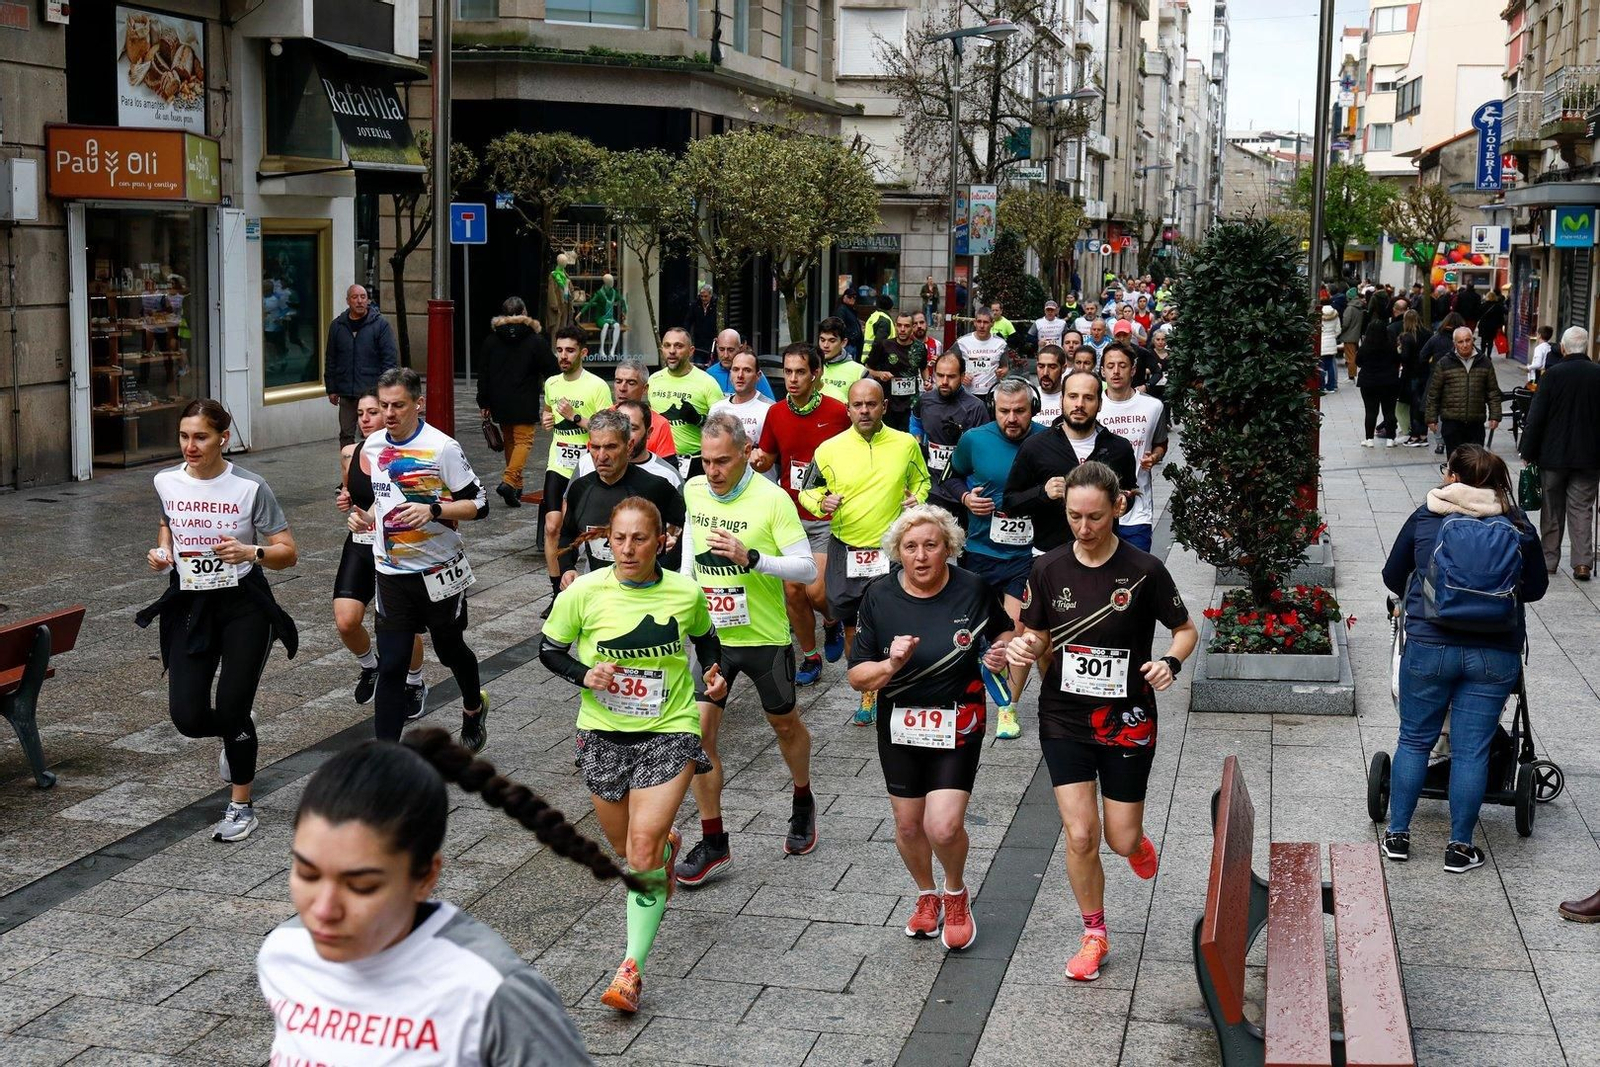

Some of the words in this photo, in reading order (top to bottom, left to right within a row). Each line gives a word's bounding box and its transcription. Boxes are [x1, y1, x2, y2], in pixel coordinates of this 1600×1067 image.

[121, 96, 133, 107] Para
[134, 97, 143, 107] los
[144, 99, 165, 110] amantes
[127, 151, 157, 175] Oli
[132, 181, 146, 189] pan
[153, 182, 178, 190] contigo
[570, 400, 584, 408] uga
[1103, 415, 1147, 425] CARREIRA
[561, 448, 580, 459] 259
[177, 501, 240, 514] CARREIRA
[171, 518, 212, 528] ALVARIO
[217, 521, 222, 529] 5
[233, 521, 238, 529] 5
[720, 519, 748, 533] auga
[1000, 520, 1026, 533] 229
[179, 535, 222, 546] Santan
[191, 558, 224, 574] 302
[436, 566, 463, 585] 116
[1057, 600, 1077, 610] Trigal
[597, 641, 681, 659] RUNNING
[1075, 657, 1112, 677] 301
[607, 677, 647, 697] 636
[904, 709, 942, 728] 619
[286, 1003, 440, 1052] CARREIRA
